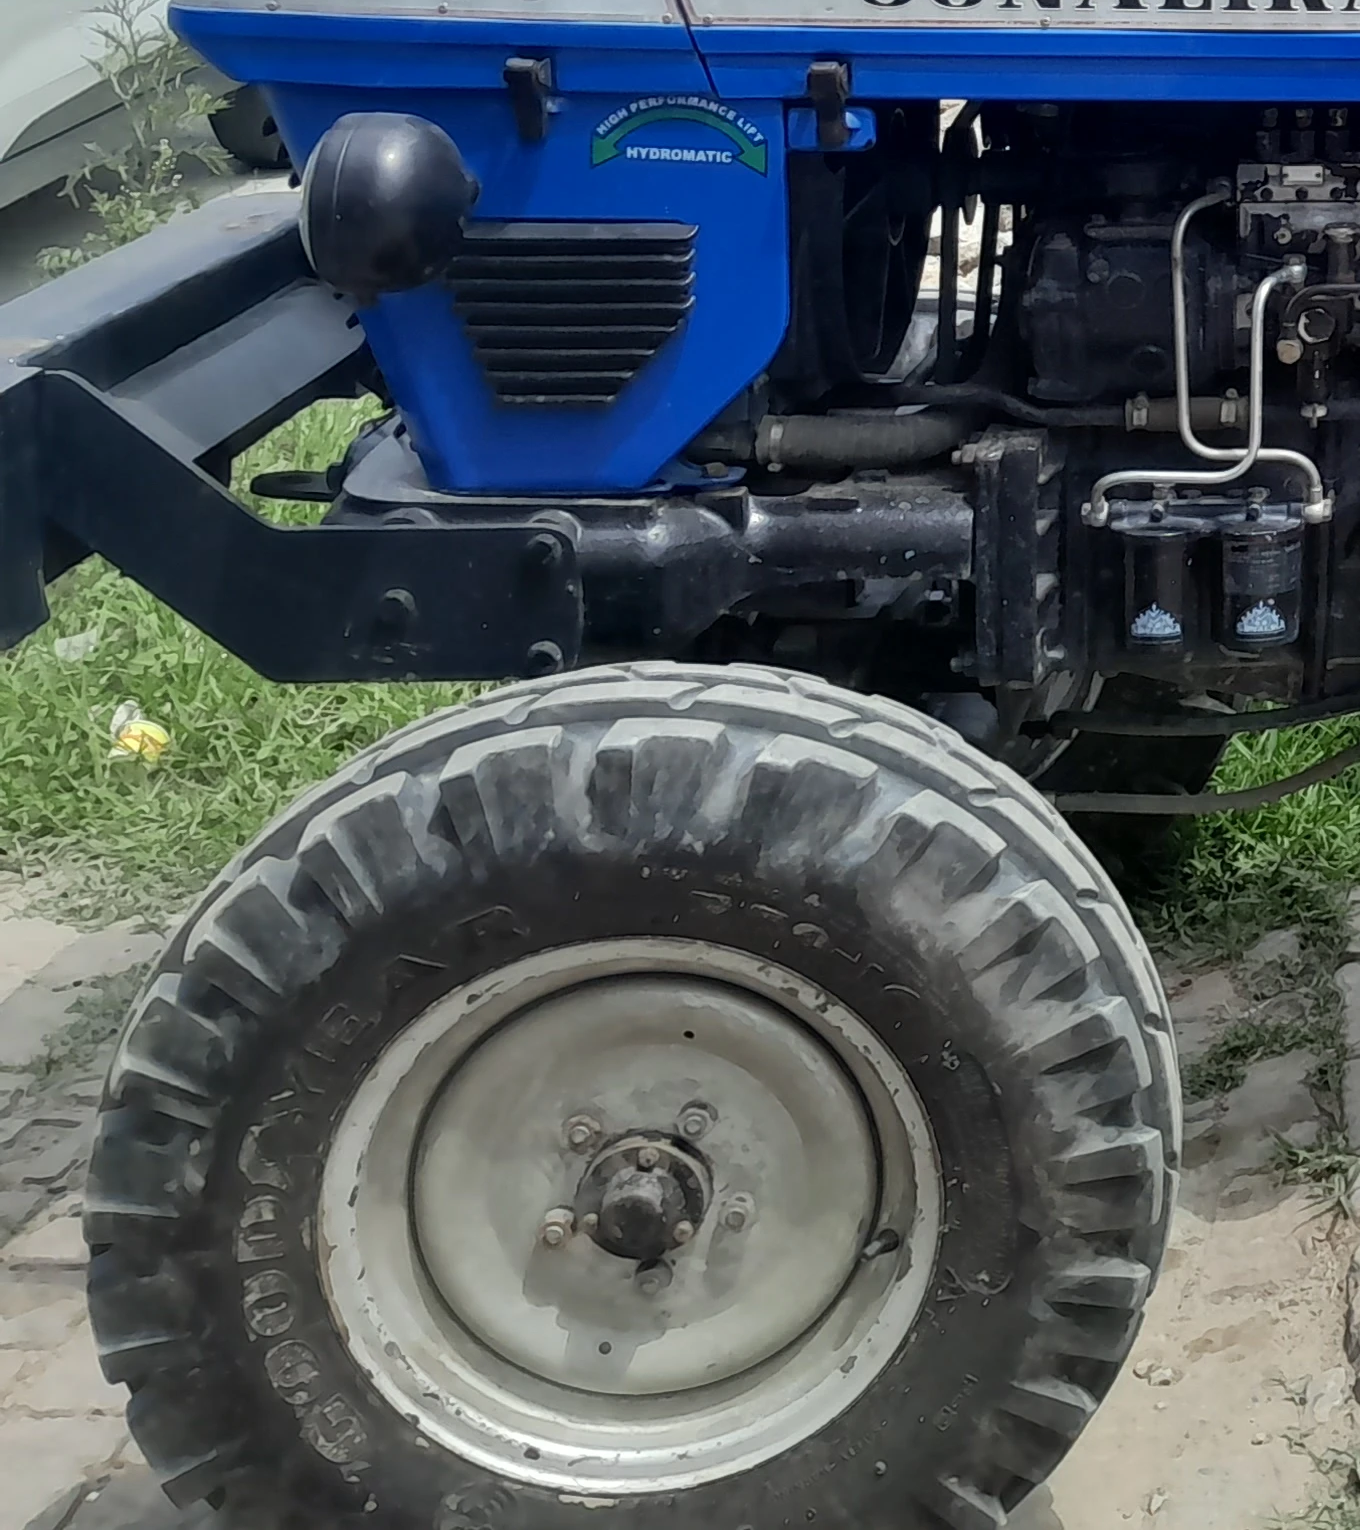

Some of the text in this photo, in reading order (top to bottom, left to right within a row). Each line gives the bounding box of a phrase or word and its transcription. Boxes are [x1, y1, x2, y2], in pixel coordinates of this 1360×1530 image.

[596, 95, 765, 143] HIGH PERFORMANCE LIFT
[626, 145, 733, 163] HYDROMATIC
